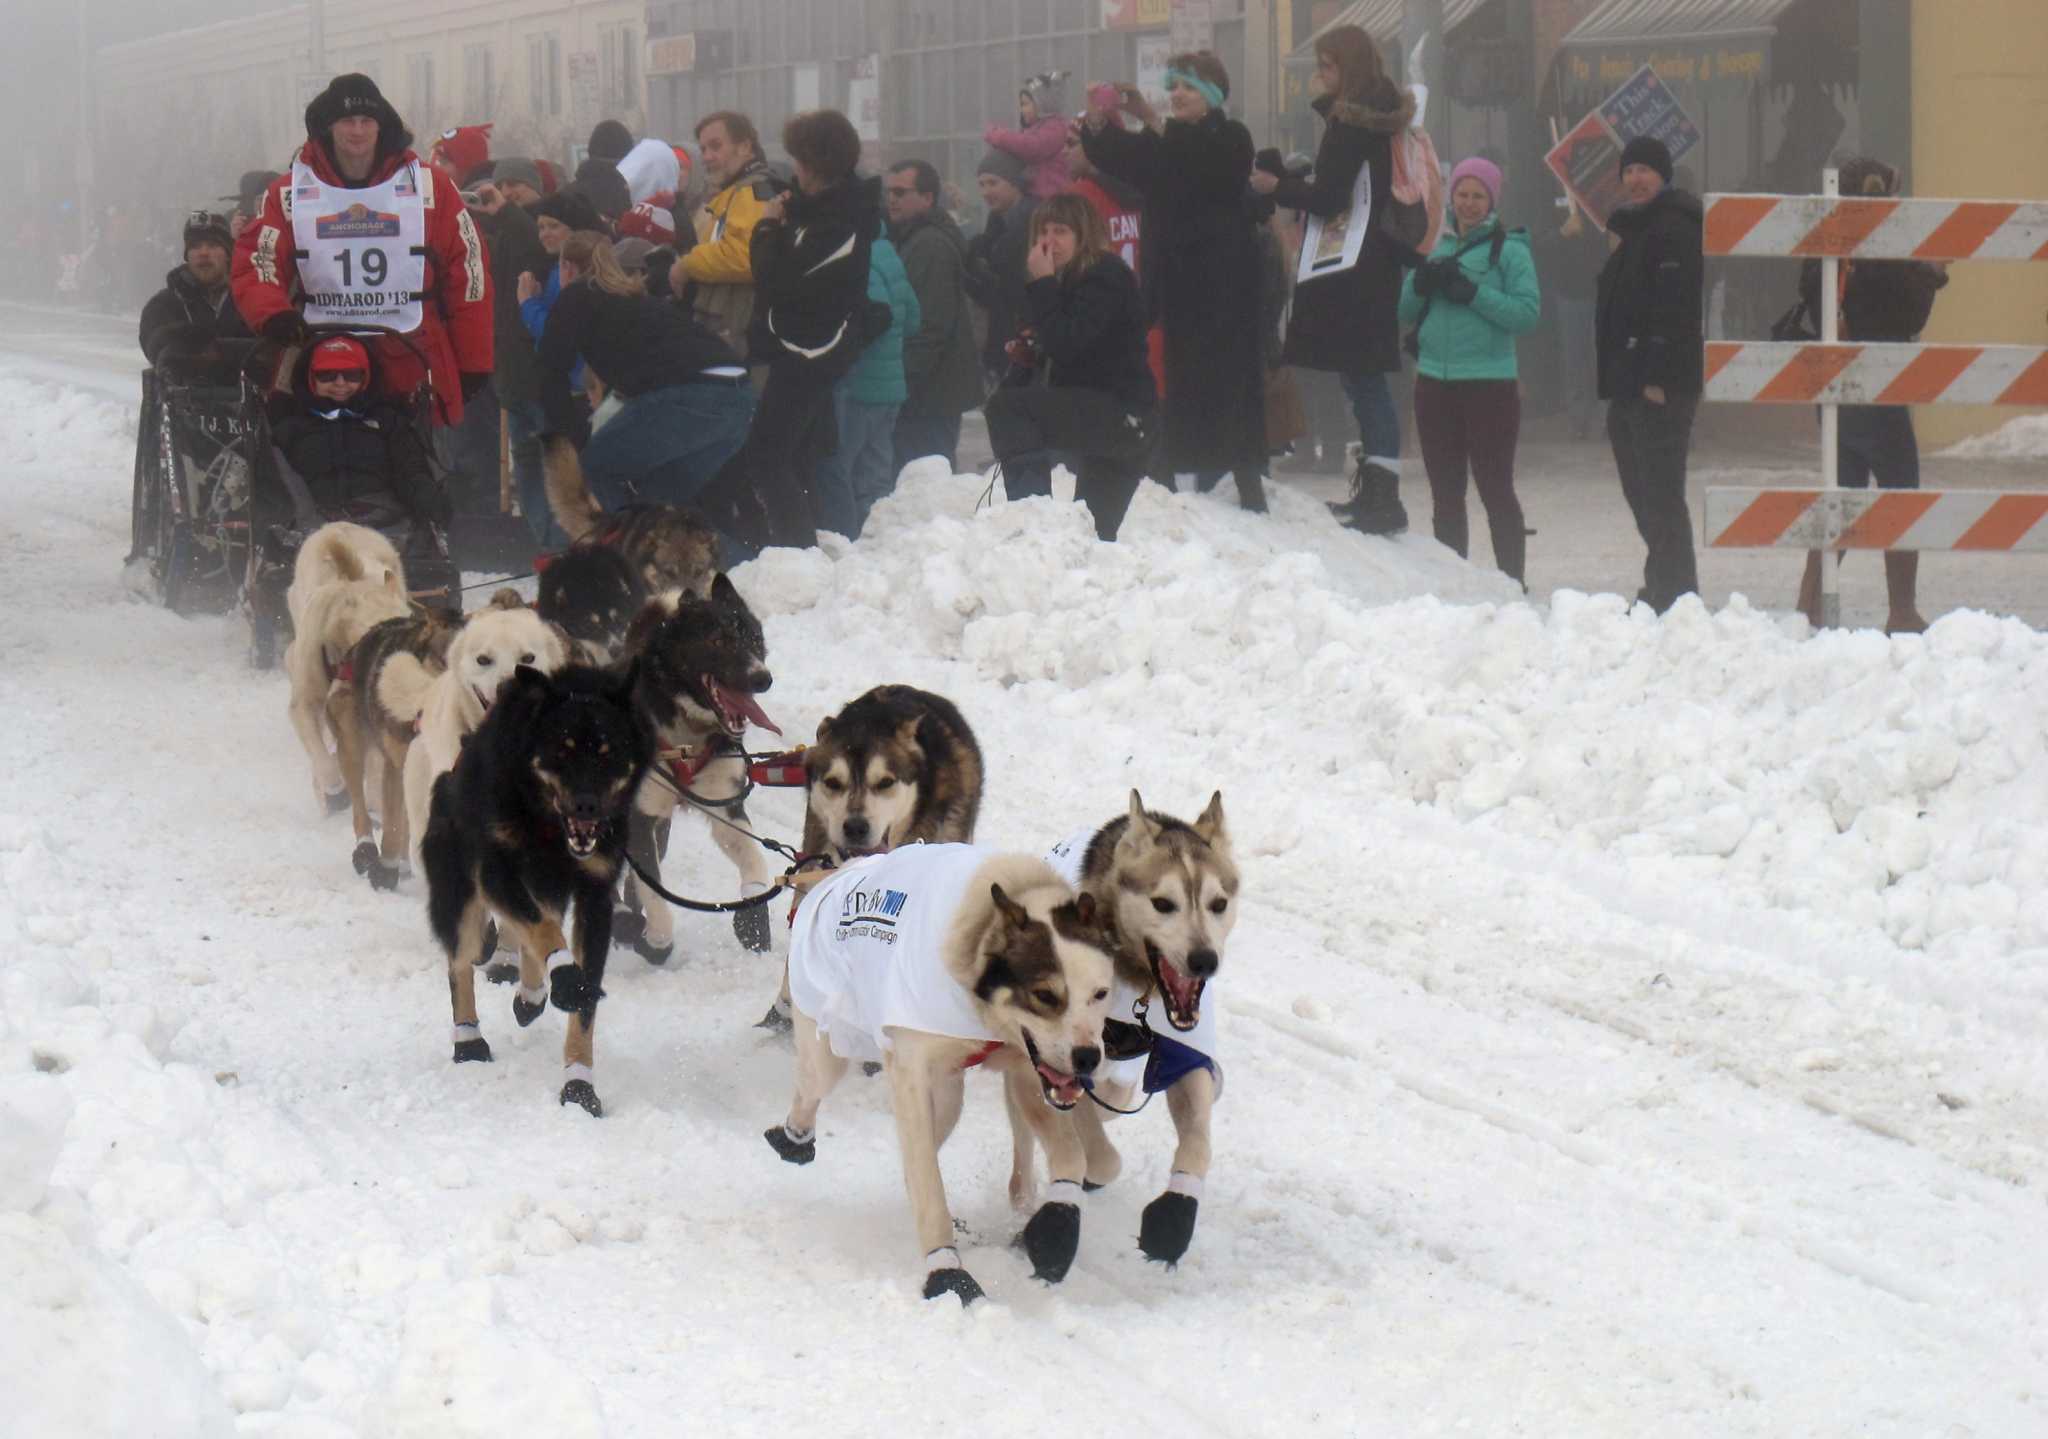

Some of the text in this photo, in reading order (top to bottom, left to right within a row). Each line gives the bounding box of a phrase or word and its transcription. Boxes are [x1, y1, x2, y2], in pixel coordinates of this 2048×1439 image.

[329, 222, 385, 232] ANCHORAGE
[333, 247, 389, 287] 19
[315, 291, 385, 307] IDITAROD
[325, 307, 401, 318] www.iditarod.com
